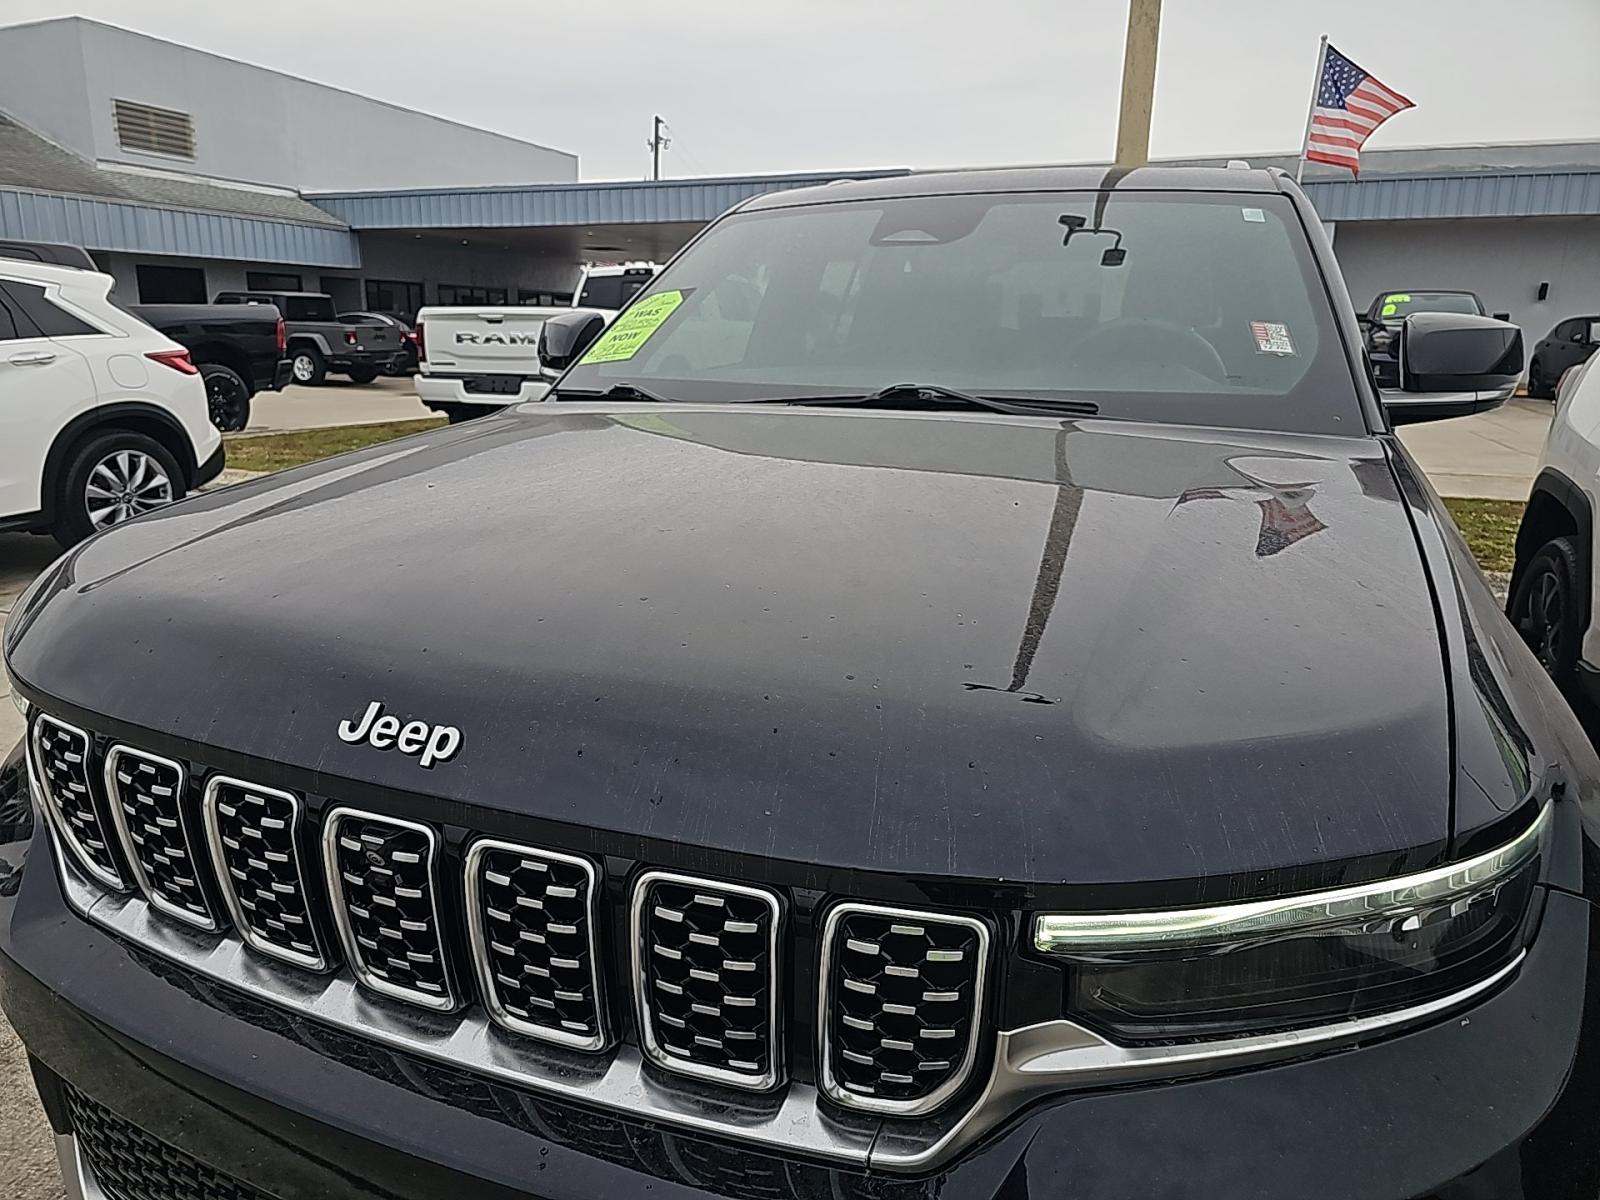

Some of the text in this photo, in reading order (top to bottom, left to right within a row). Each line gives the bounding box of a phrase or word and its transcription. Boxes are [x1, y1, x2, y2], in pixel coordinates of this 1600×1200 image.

[633, 308, 662, 319] WAS
[455, 332, 537, 345] RAM
[608, 331, 642, 343] NOW
[338, 701, 462, 768] Jeep
